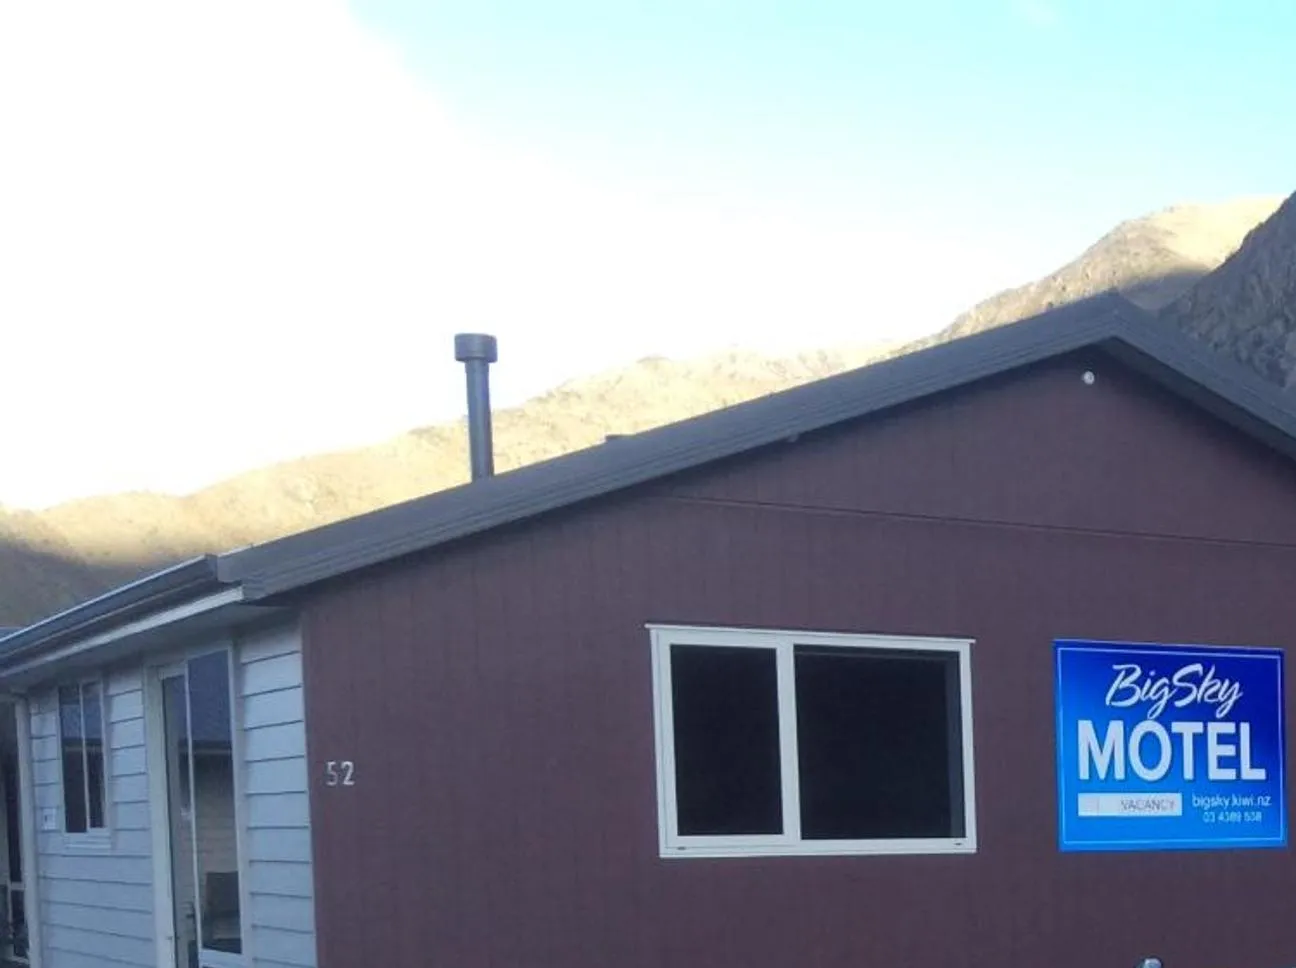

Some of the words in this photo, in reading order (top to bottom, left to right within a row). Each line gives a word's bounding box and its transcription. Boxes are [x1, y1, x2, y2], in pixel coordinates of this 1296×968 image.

[1077, 719, 1267, 782] MOTEL
[326, 761, 355, 786] 52
[1120, 798, 1175, 811] VACANCY
